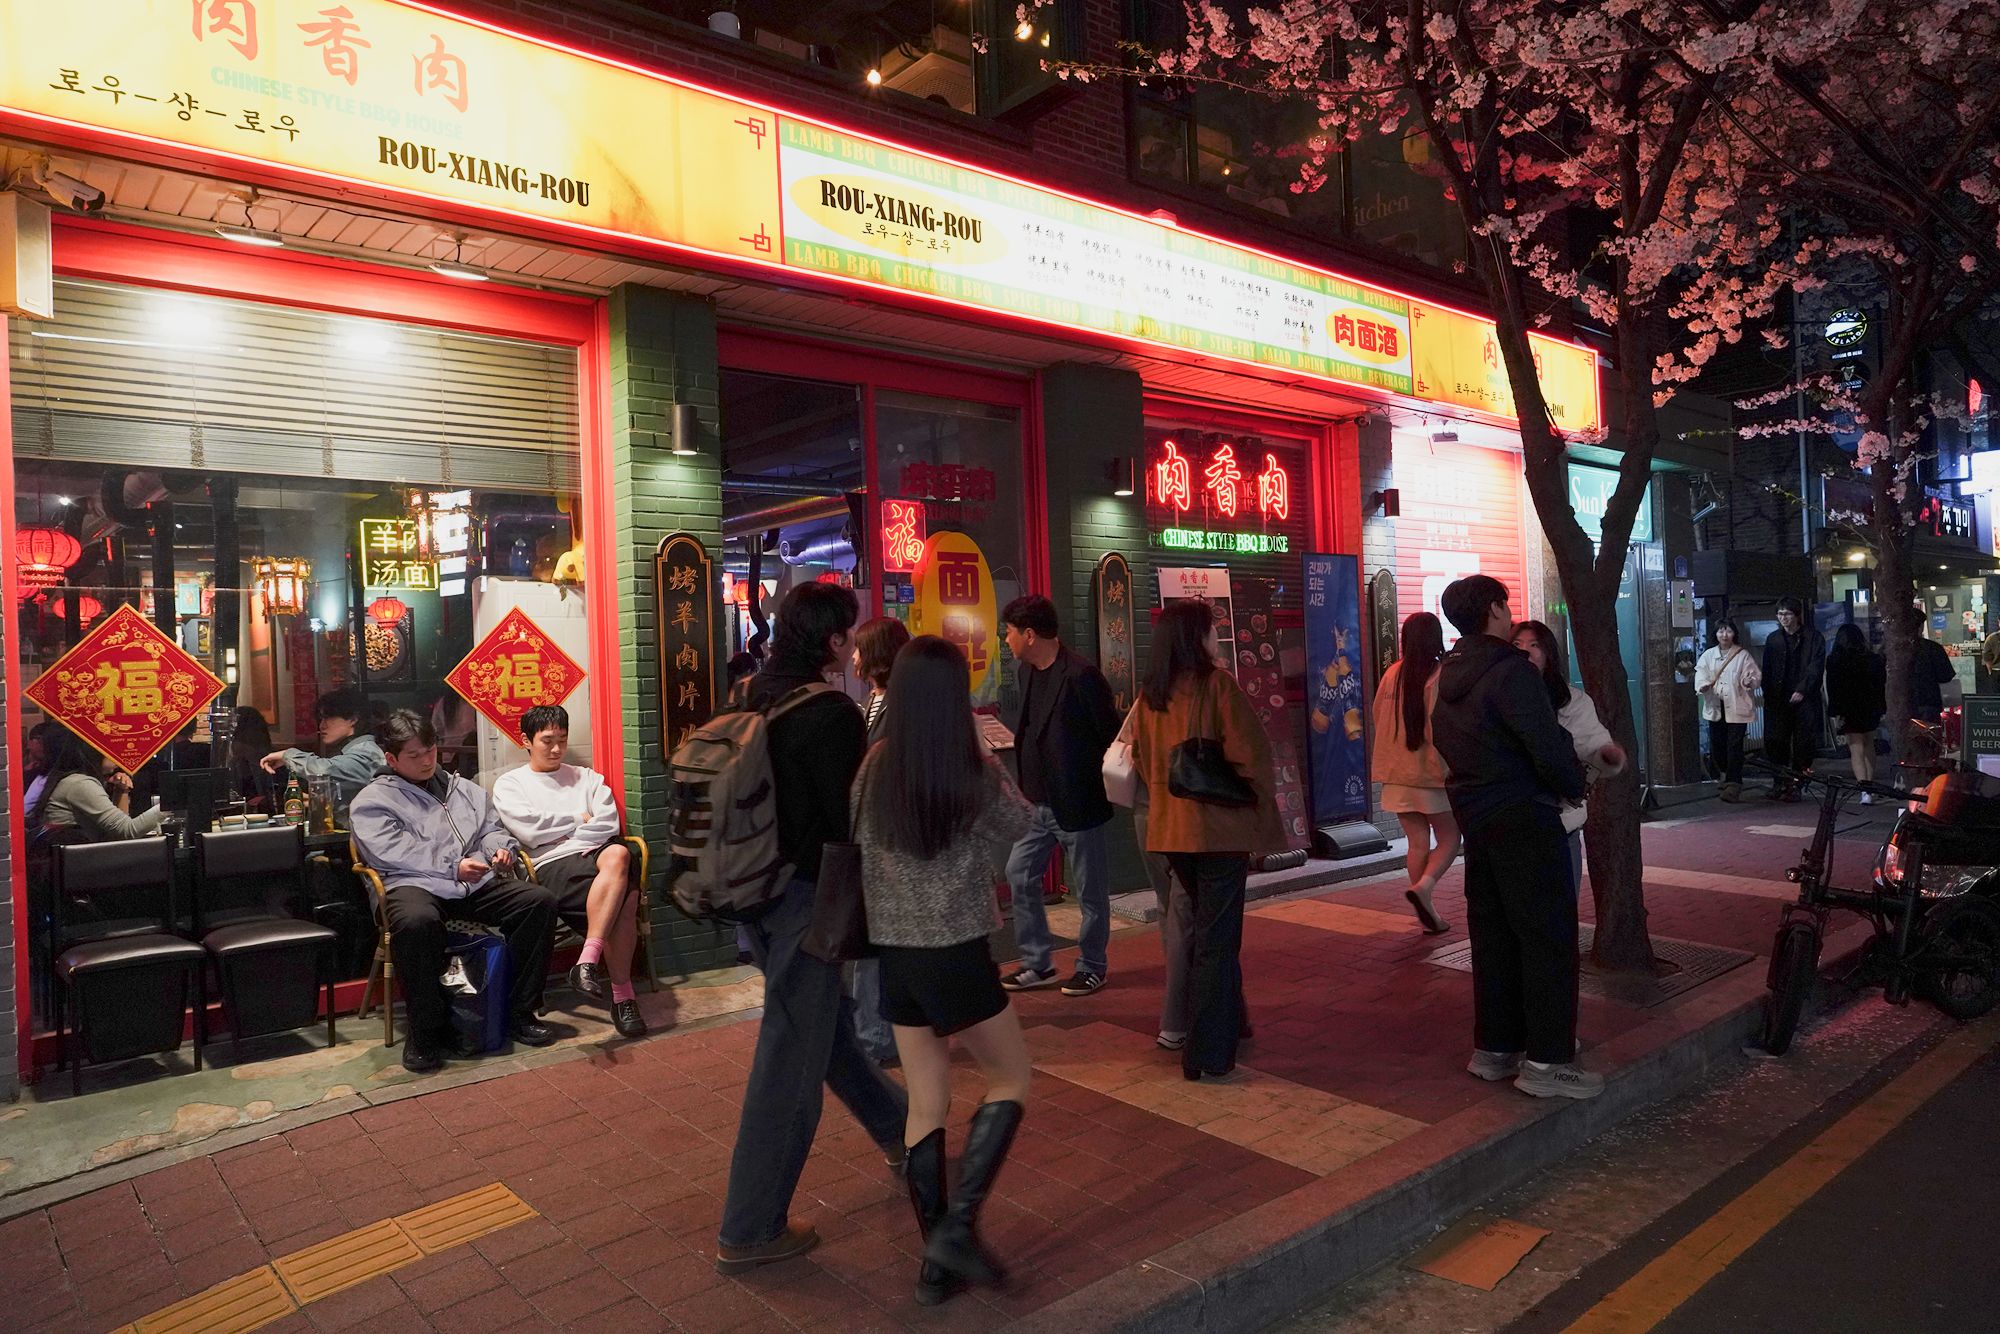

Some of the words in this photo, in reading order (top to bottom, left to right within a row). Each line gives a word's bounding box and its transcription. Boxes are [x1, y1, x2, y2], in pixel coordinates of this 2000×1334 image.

[210, 66, 293, 103] CHINESE
[296, 83, 357, 118] STYLE
[359, 99, 402, 129] BBQ
[404, 111, 464, 141] HOUSE
[377, 135, 592, 208] ROU-XIANG-ROU
[788, 124, 835, 154] LAMB
[841, 137, 877, 168] BBQ
[888, 152, 952, 184] CHICKEN
[957, 170, 988, 195] BBQ
[820, 179, 982, 244] ROU-XIANG-ROU
[794, 243, 840, 270] LAMB
[846, 255, 882, 281] BBQ
[893, 264, 956, 295] CHICKEN
[962, 278, 993, 301] BBQ
[1257, 255, 1287, 279] SALAD
[1292, 268, 1321, 290] DRINK
[1327, 278, 1357, 300] LIQUOR
[1363, 289, 1404, 314] BEVERAGE
[1209, 335, 1256, 359] STIR-FRY
[1263, 347, 1291, 366] SALAD
[1298, 352, 1325, 373] DRINK
[1332, 360, 1363, 380] LIQUOR
[1368, 367, 1408, 392] BEVERAGE
[1334, 313, 1398, 358] 肉面酒
[1156, 440, 1288, 519] 肉香肉
[1164, 528, 1205, 549] CHINESE
[1206, 532, 1235, 551] STYLE
[1236, 534, 1258, 553] BBQ
[1260, 535, 1288, 553] HOUSE
[1308, 562, 1332, 577] 진짜가
[1308, 577, 1325, 592] 되는
[1308, 593, 1325, 608] 시간
[95, 660, 163, 716] 福
[494, 653, 545, 700] 福
[1553, 1072, 1580, 1083] HOKA
